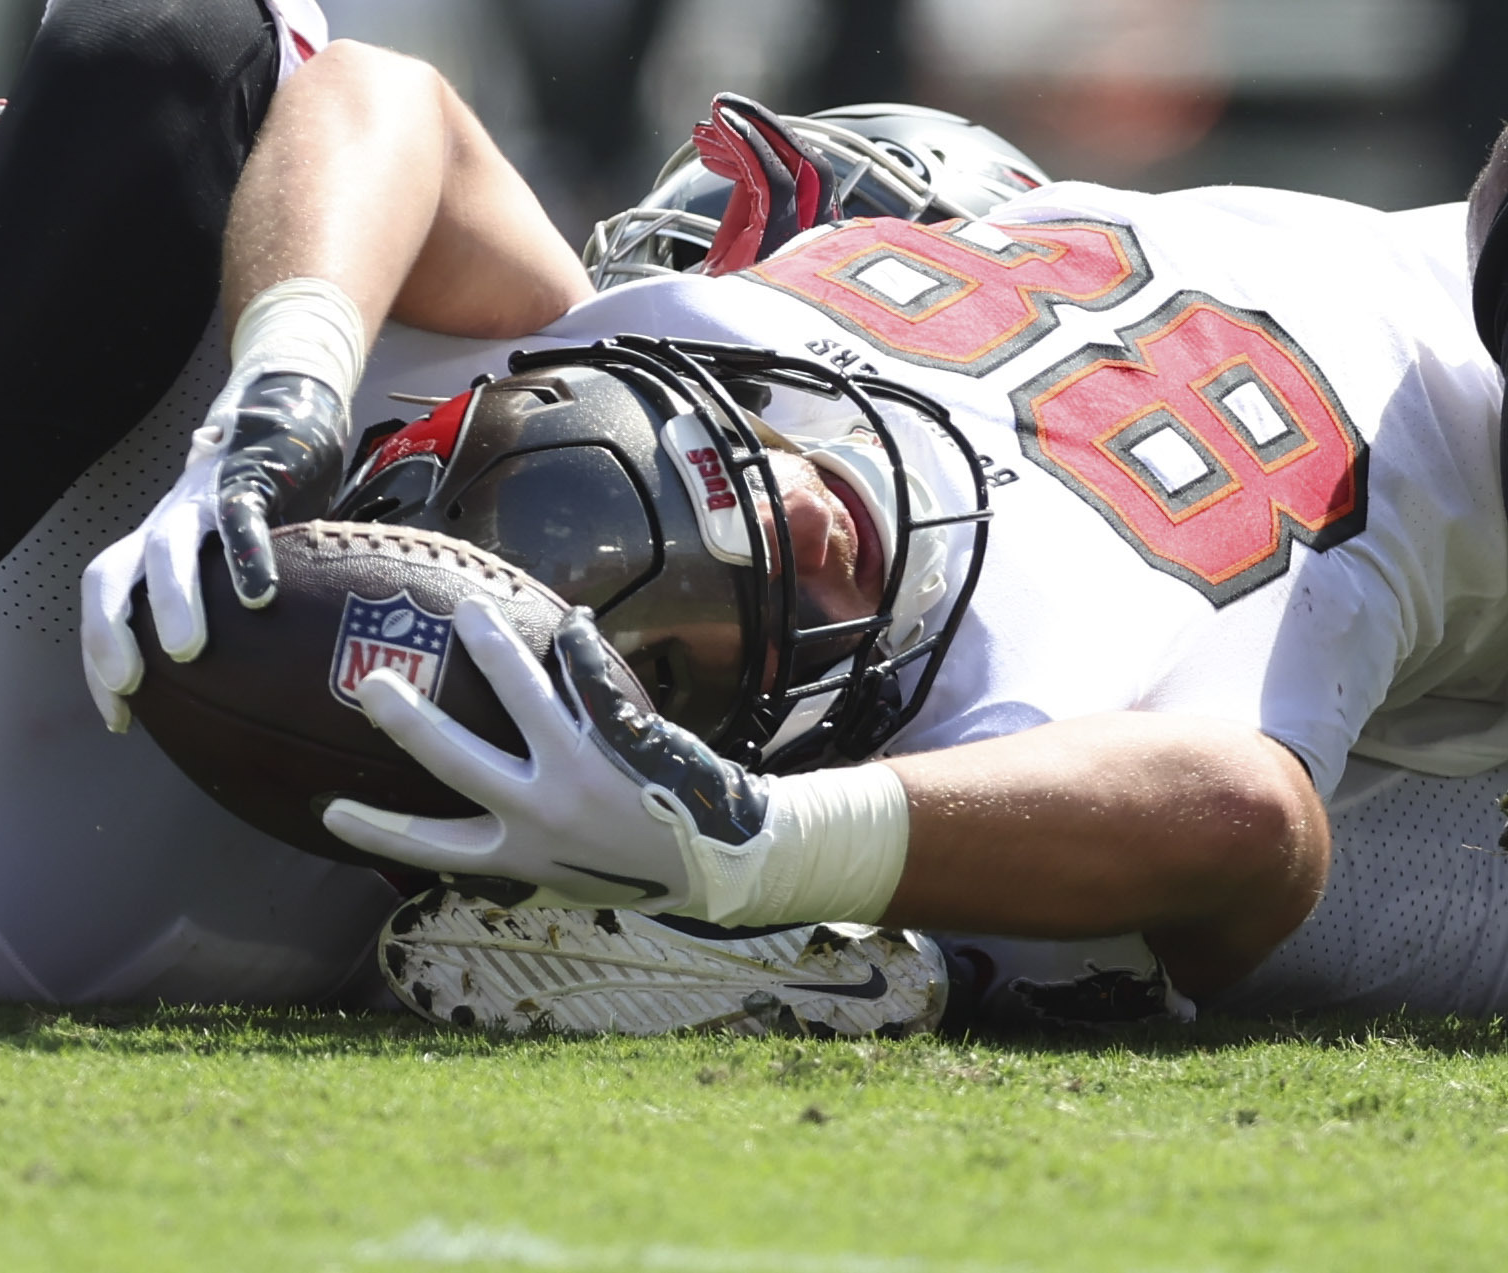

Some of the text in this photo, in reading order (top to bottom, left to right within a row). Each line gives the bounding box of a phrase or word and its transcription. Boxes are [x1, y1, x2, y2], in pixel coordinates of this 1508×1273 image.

[735, 216, 1371, 610] 88
[685, 446, 738, 513] BUCS
[342, 639, 428, 694] NFL
